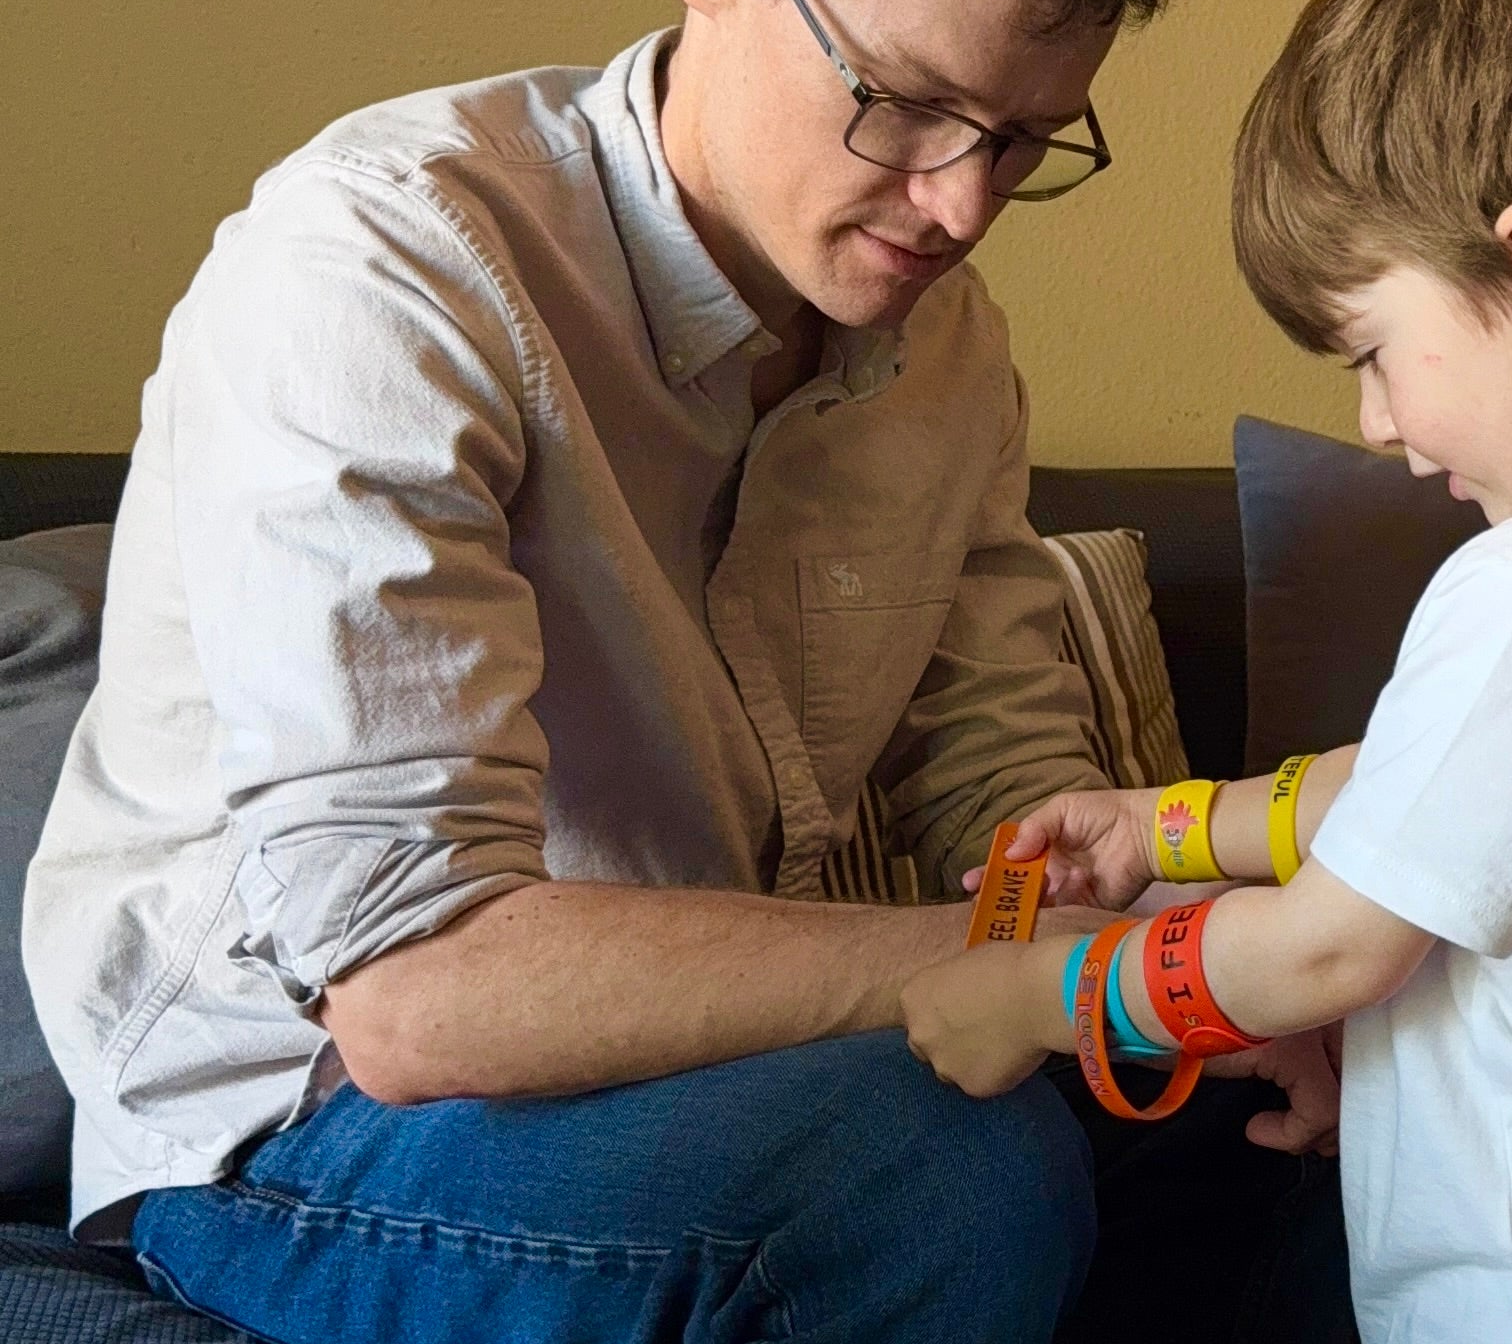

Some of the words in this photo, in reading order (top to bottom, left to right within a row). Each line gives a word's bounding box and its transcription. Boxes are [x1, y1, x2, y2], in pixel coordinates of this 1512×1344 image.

[995, 868, 1029, 912] BRAVE
[987, 916, 1018, 942] EEL
[1166, 982, 1194, 1004] I
